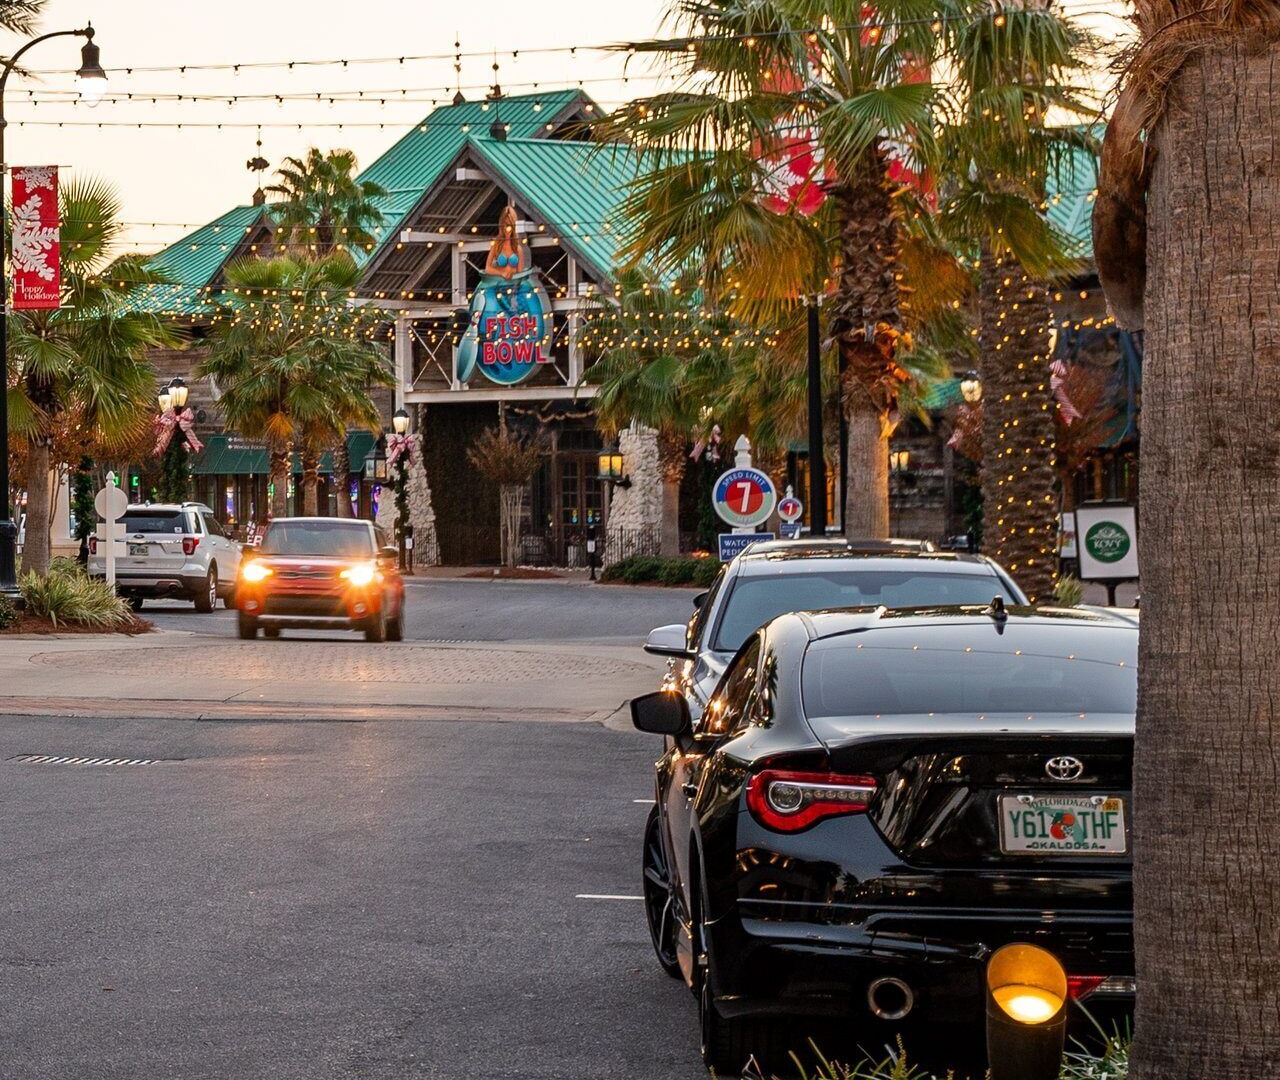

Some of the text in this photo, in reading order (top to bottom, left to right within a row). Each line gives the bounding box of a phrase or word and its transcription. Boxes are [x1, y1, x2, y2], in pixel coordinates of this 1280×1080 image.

[13, 278, 44, 295] Happy
[24, 292, 59, 300] Holidays
[486, 315, 538, 339] FISH
[483, 341, 550, 365] BOWL
[722, 473, 766, 487] SPEED LIMIT
[737, 482, 751, 513] 7
[786, 503, 793, 516] 7
[1009, 810, 1118, 839] Y61 THF
[1031, 841, 1099, 850] OKALOOSA
